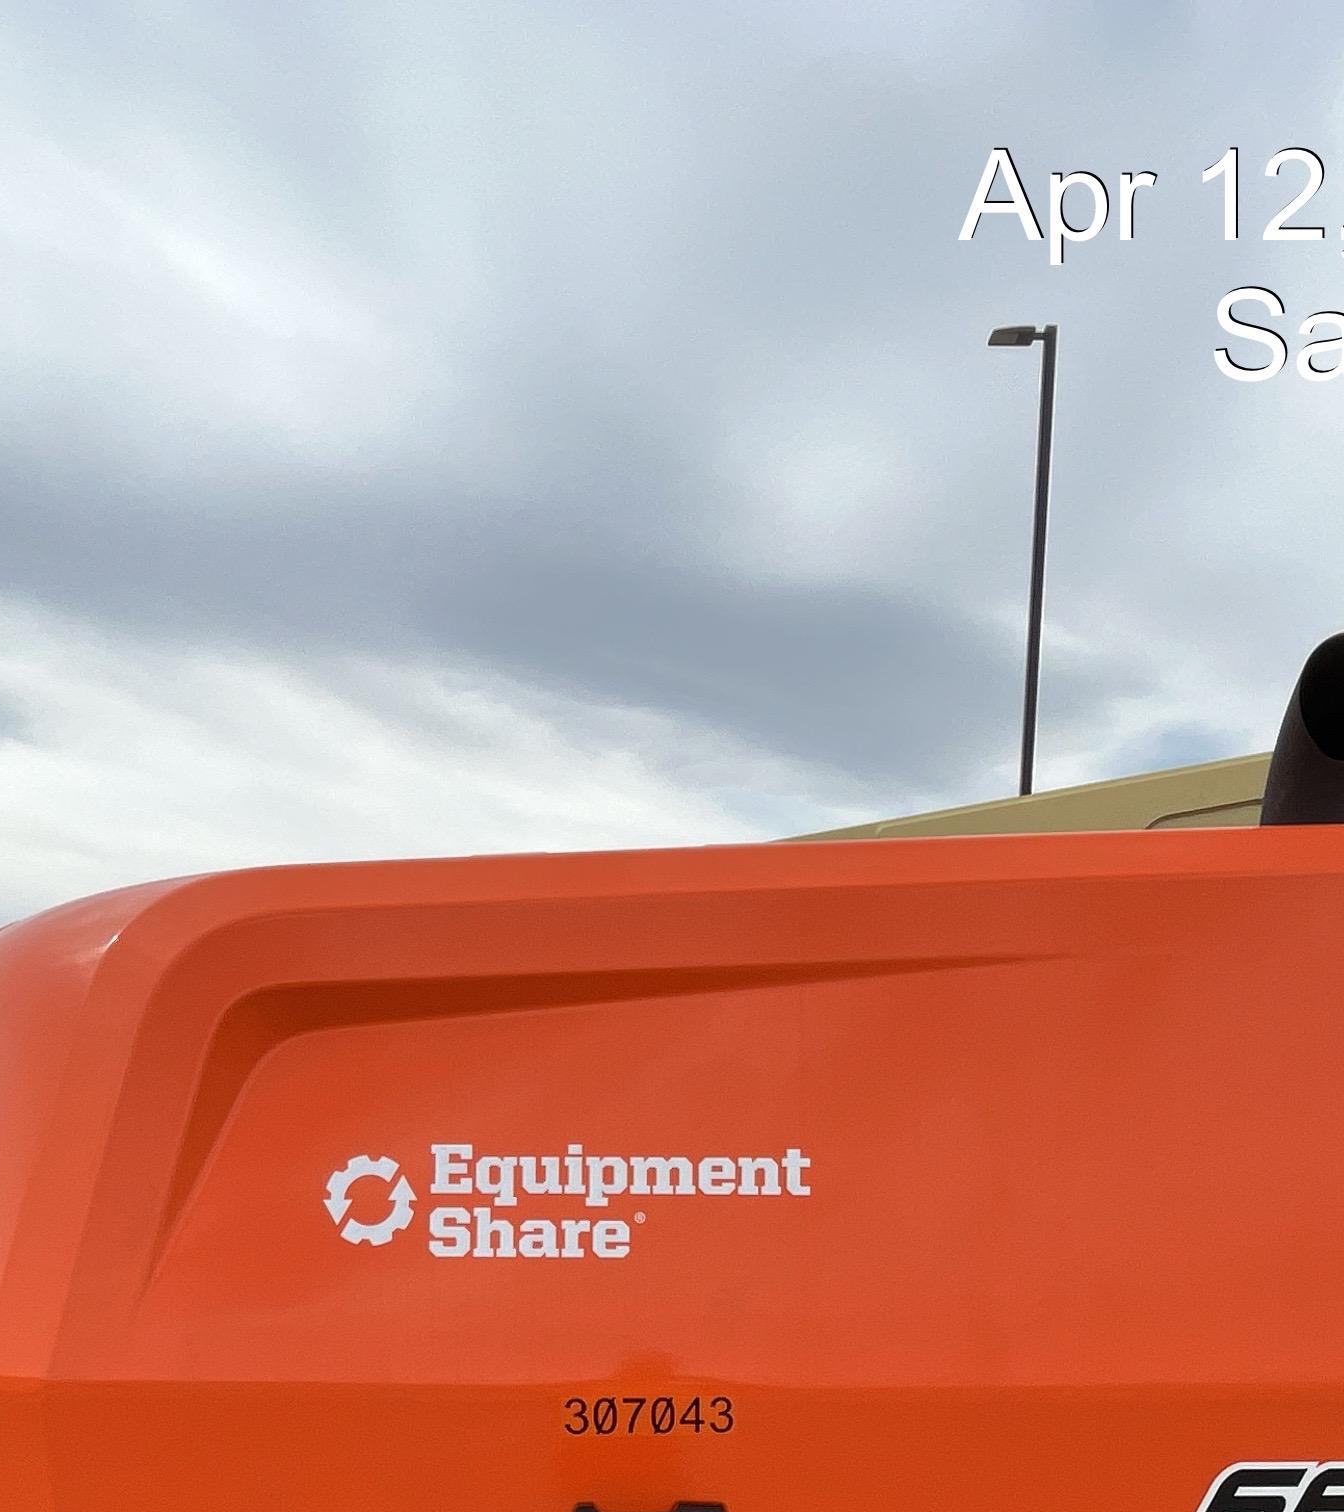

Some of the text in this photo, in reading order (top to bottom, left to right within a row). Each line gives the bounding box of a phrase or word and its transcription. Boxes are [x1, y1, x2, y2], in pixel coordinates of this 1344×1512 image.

[430, 1143, 811, 1207] Equipment
[428, 1206, 631, 1259] Share
[563, 1396, 735, 1436] 307043
